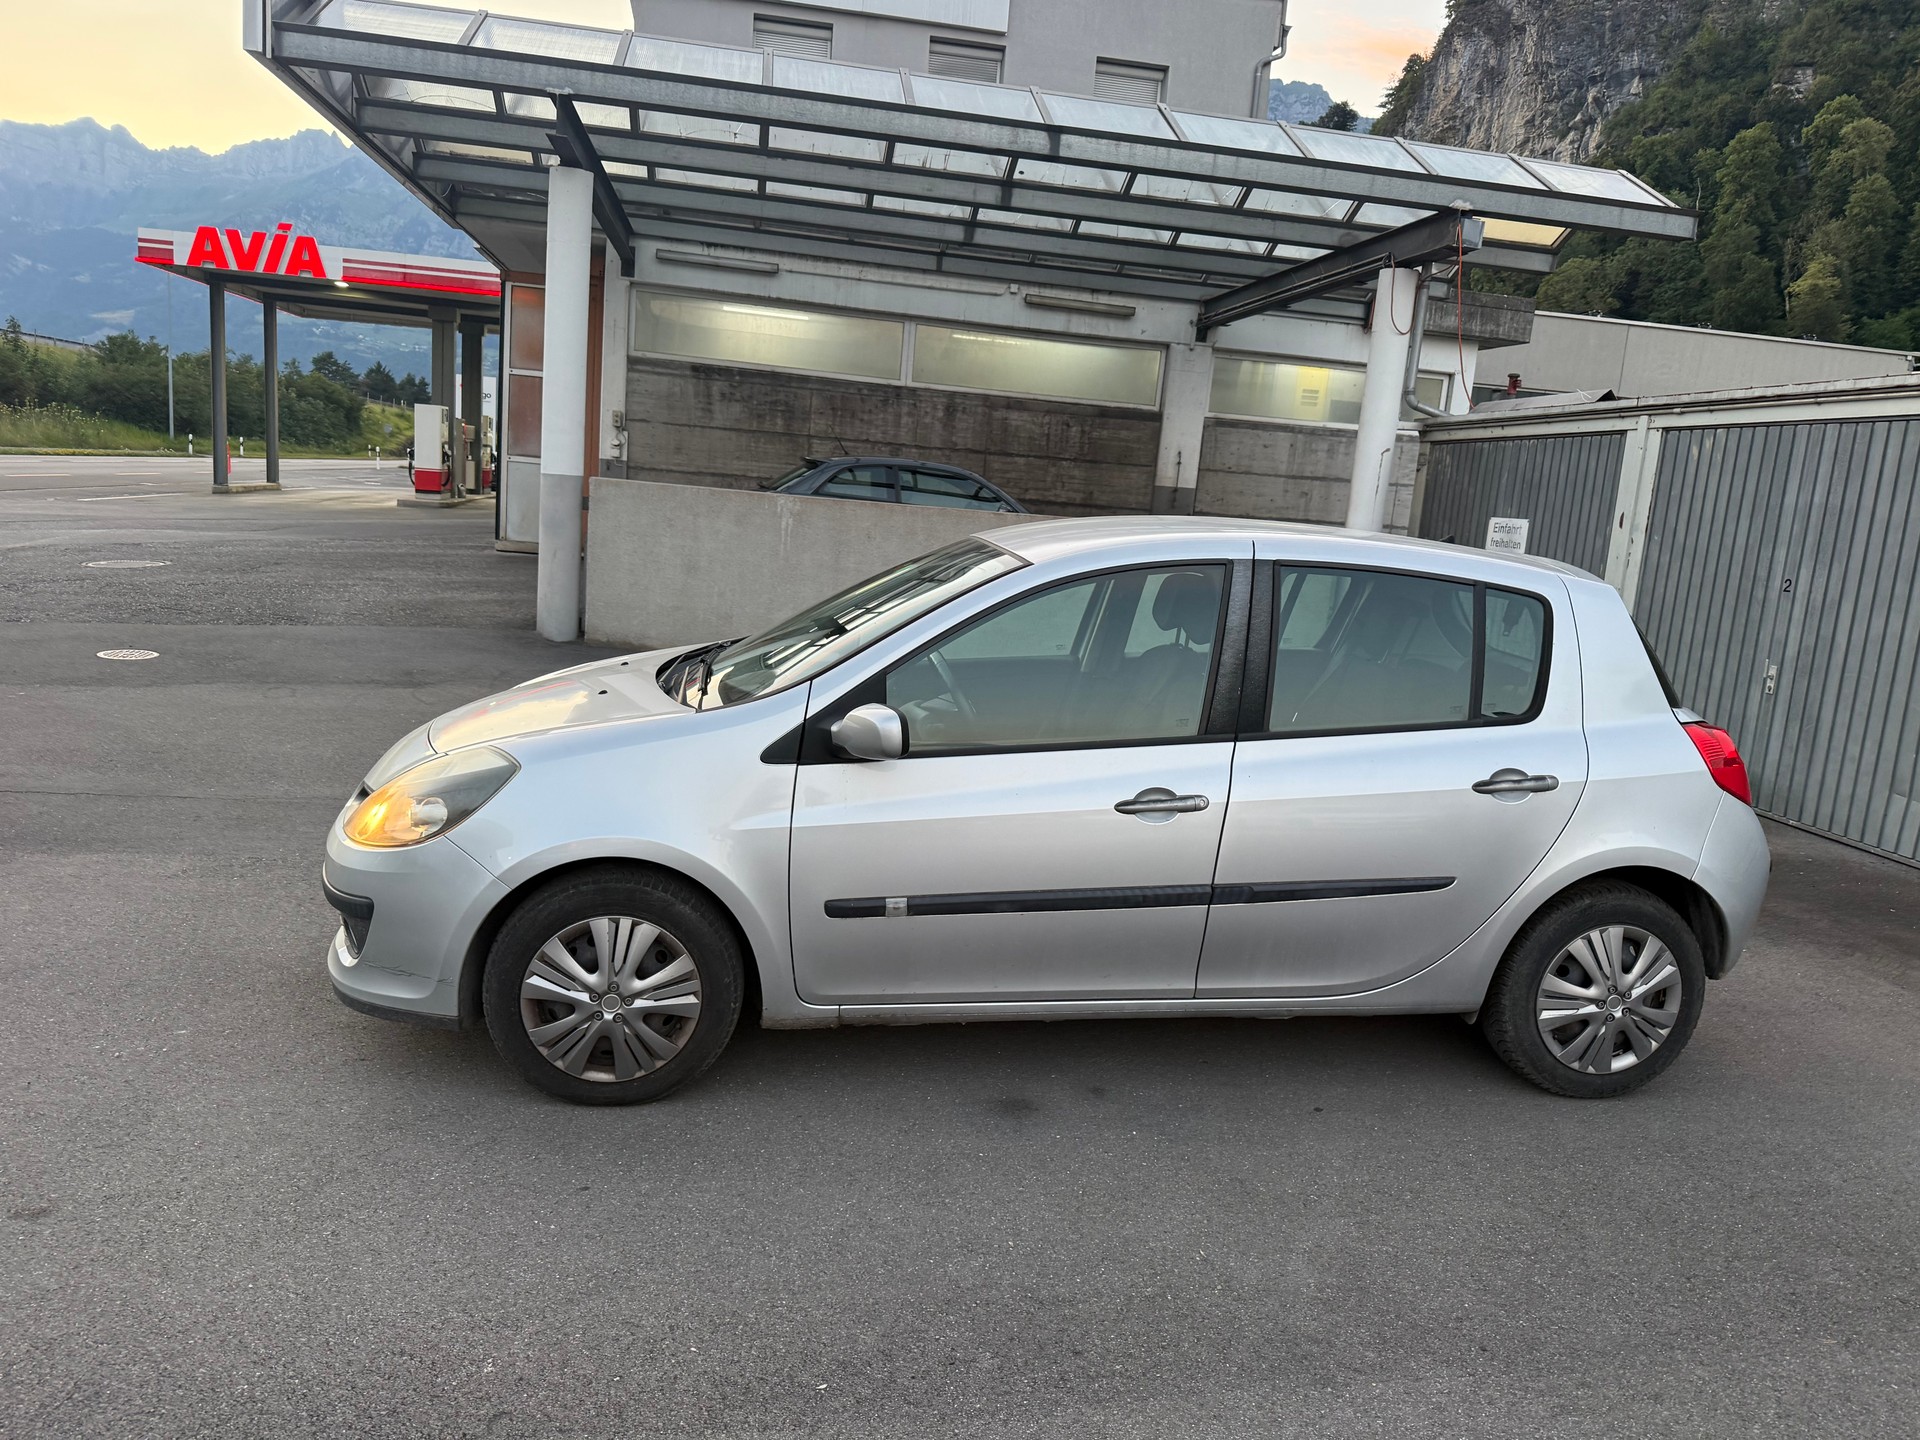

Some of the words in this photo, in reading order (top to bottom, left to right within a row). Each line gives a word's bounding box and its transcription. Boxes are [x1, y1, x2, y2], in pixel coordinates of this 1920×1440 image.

[1493, 522, 1522, 535] Einfahrt
[1490, 537, 1522, 550] freihalten
[1783, 578, 1792, 592] 2
